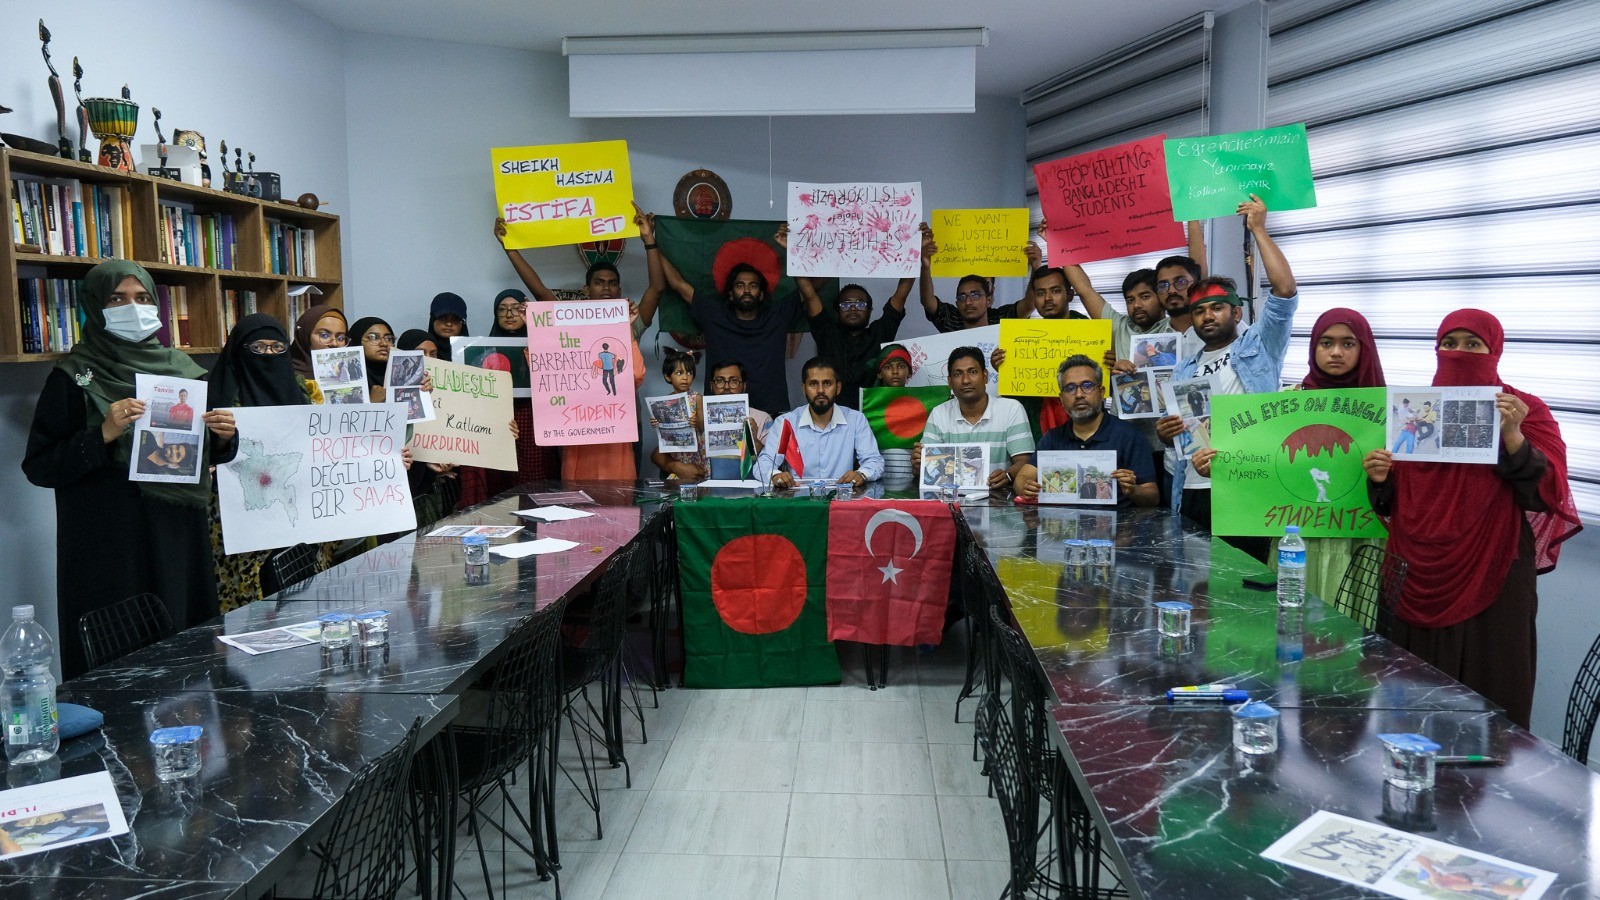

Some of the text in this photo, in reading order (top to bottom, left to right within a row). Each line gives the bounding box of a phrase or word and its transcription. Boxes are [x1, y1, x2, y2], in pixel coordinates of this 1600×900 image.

[501, 158, 559, 174] SHEIKH
[1057, 164, 1089, 188] STOP
[1063, 174, 1146, 206] BANGLADESHI
[1239, 180, 1271, 190] HAYIR
[506, 198, 593, 223] İSTİFA
[1072, 193, 1135, 218] STUDENTS
[590, 216, 625, 234] ET
[944, 213, 1010, 227] WE WANT
[940, 243, 967, 254] Adalet
[532, 306, 624, 327] WE CONDEMN
[559, 332, 580, 348] the
[530, 351, 592, 372] BARBARIC
[539, 373, 591, 392] ATTACKS
[1011, 382, 1026, 392] ON
[550, 396, 566, 406] on
[308, 410, 396, 436] BU ARTIK
[562, 403, 627, 425] STUDENTS
[1229, 411, 1258, 434] ALL
[1260, 398, 1300, 421] EYES
[1304, 397, 1327, 413] ON
[543, 426, 616, 438] BY THE GOVERNMENT
[312, 435, 393, 463] PROTESTO
[413, 433, 480, 455] DURDURUN
[373, 459, 396, 482] BU
[1228, 468, 1269, 482] MARTYRS
[353, 484, 405, 512] SAVAŞ
[1264, 503, 1374, 531] STUDENTS
